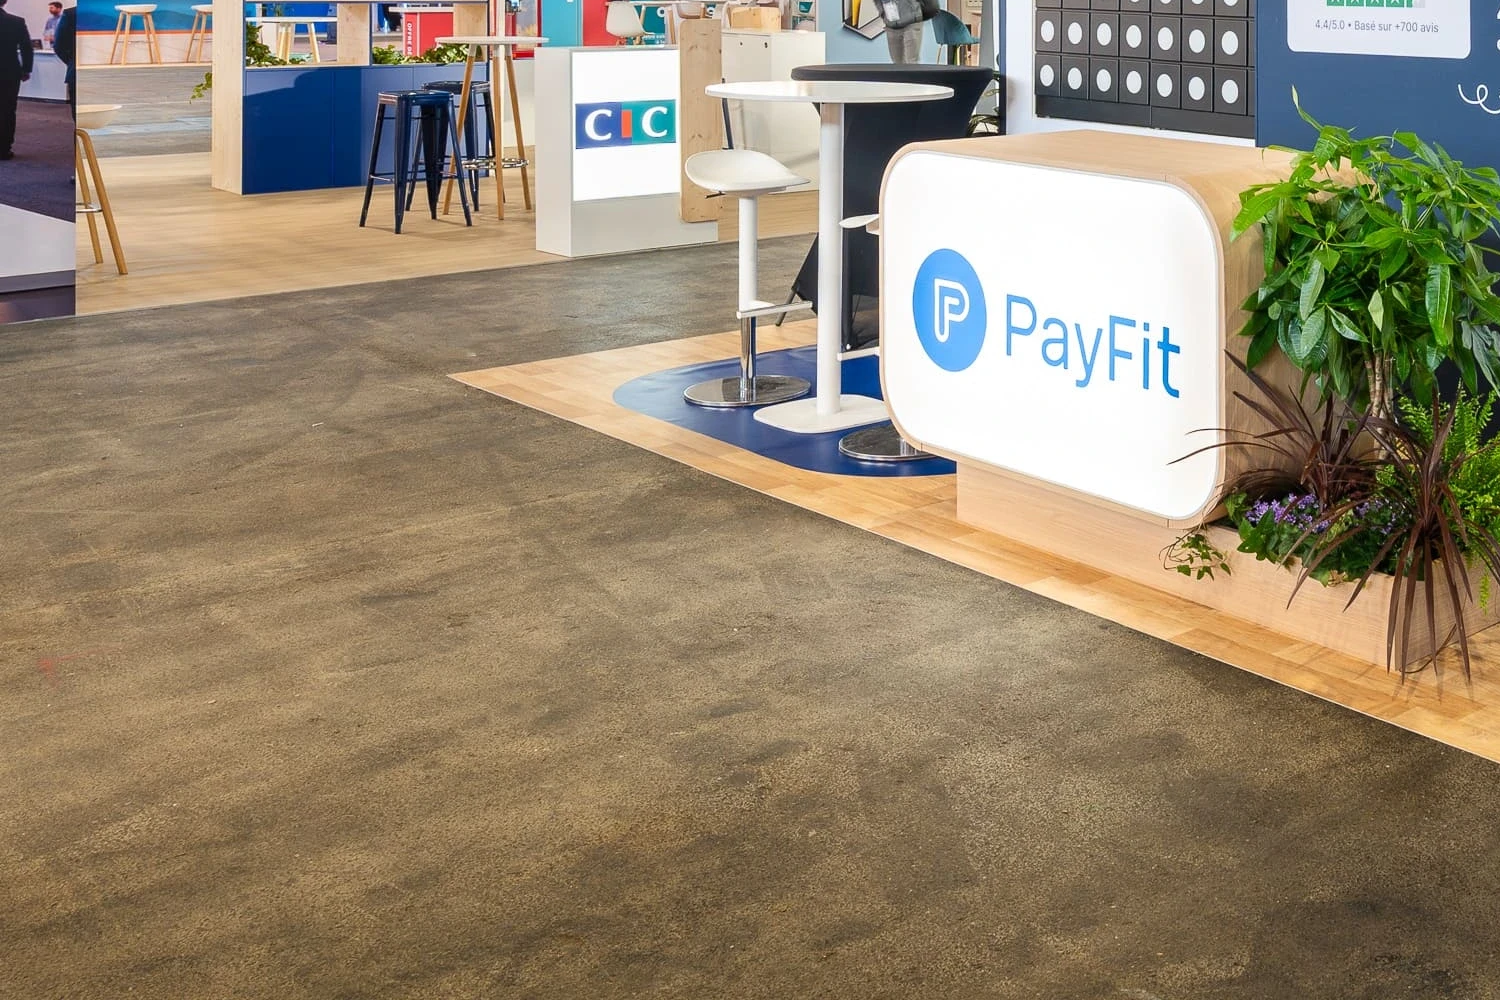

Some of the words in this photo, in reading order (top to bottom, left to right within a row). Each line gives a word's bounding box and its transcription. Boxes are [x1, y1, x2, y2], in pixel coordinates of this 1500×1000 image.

[1315, 19, 1345, 30] 4.4/5.0
[1354, 20, 1375, 31] Basé
[1378, 23, 1392, 32] sur
[1395, 21, 1418, 32] +700
[1420, 22, 1439, 33] avis
[585, 106, 668, 141] CIC
[1006, 293, 1181, 399] PayFit
